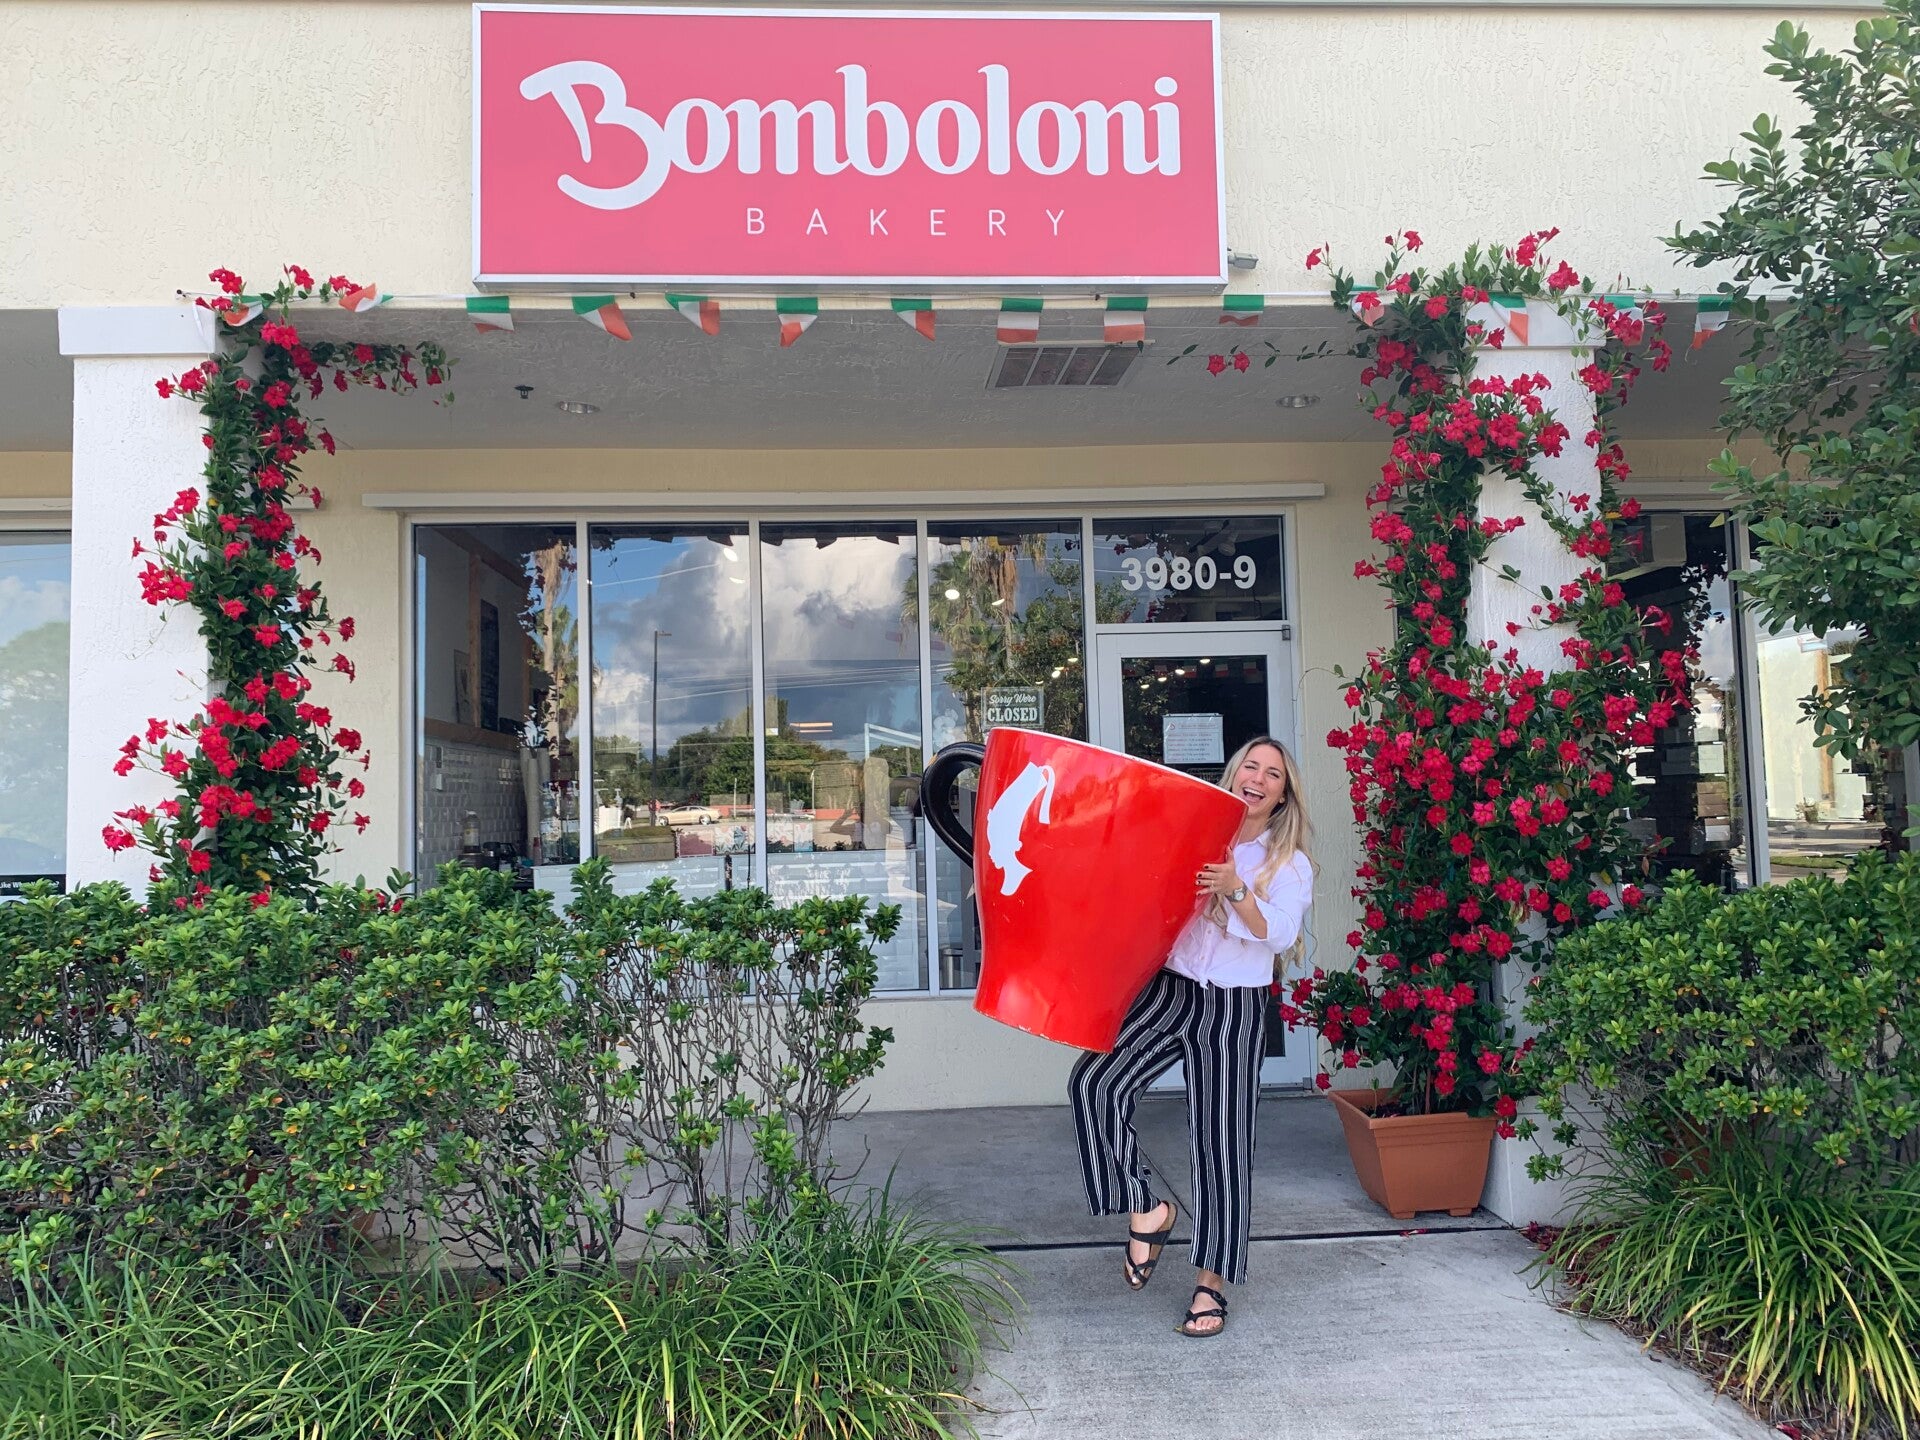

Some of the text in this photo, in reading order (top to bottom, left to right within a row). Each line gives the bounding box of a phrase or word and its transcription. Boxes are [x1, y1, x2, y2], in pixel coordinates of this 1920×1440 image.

[519, 60, 1181, 210] Bomboloni
[747, 208, 1065, 236] BAKERY
[1121, 555, 1257, 591] 3980-9
[989, 694, 1013, 706] Sorry
[987, 707, 1038, 722] CLOSED
